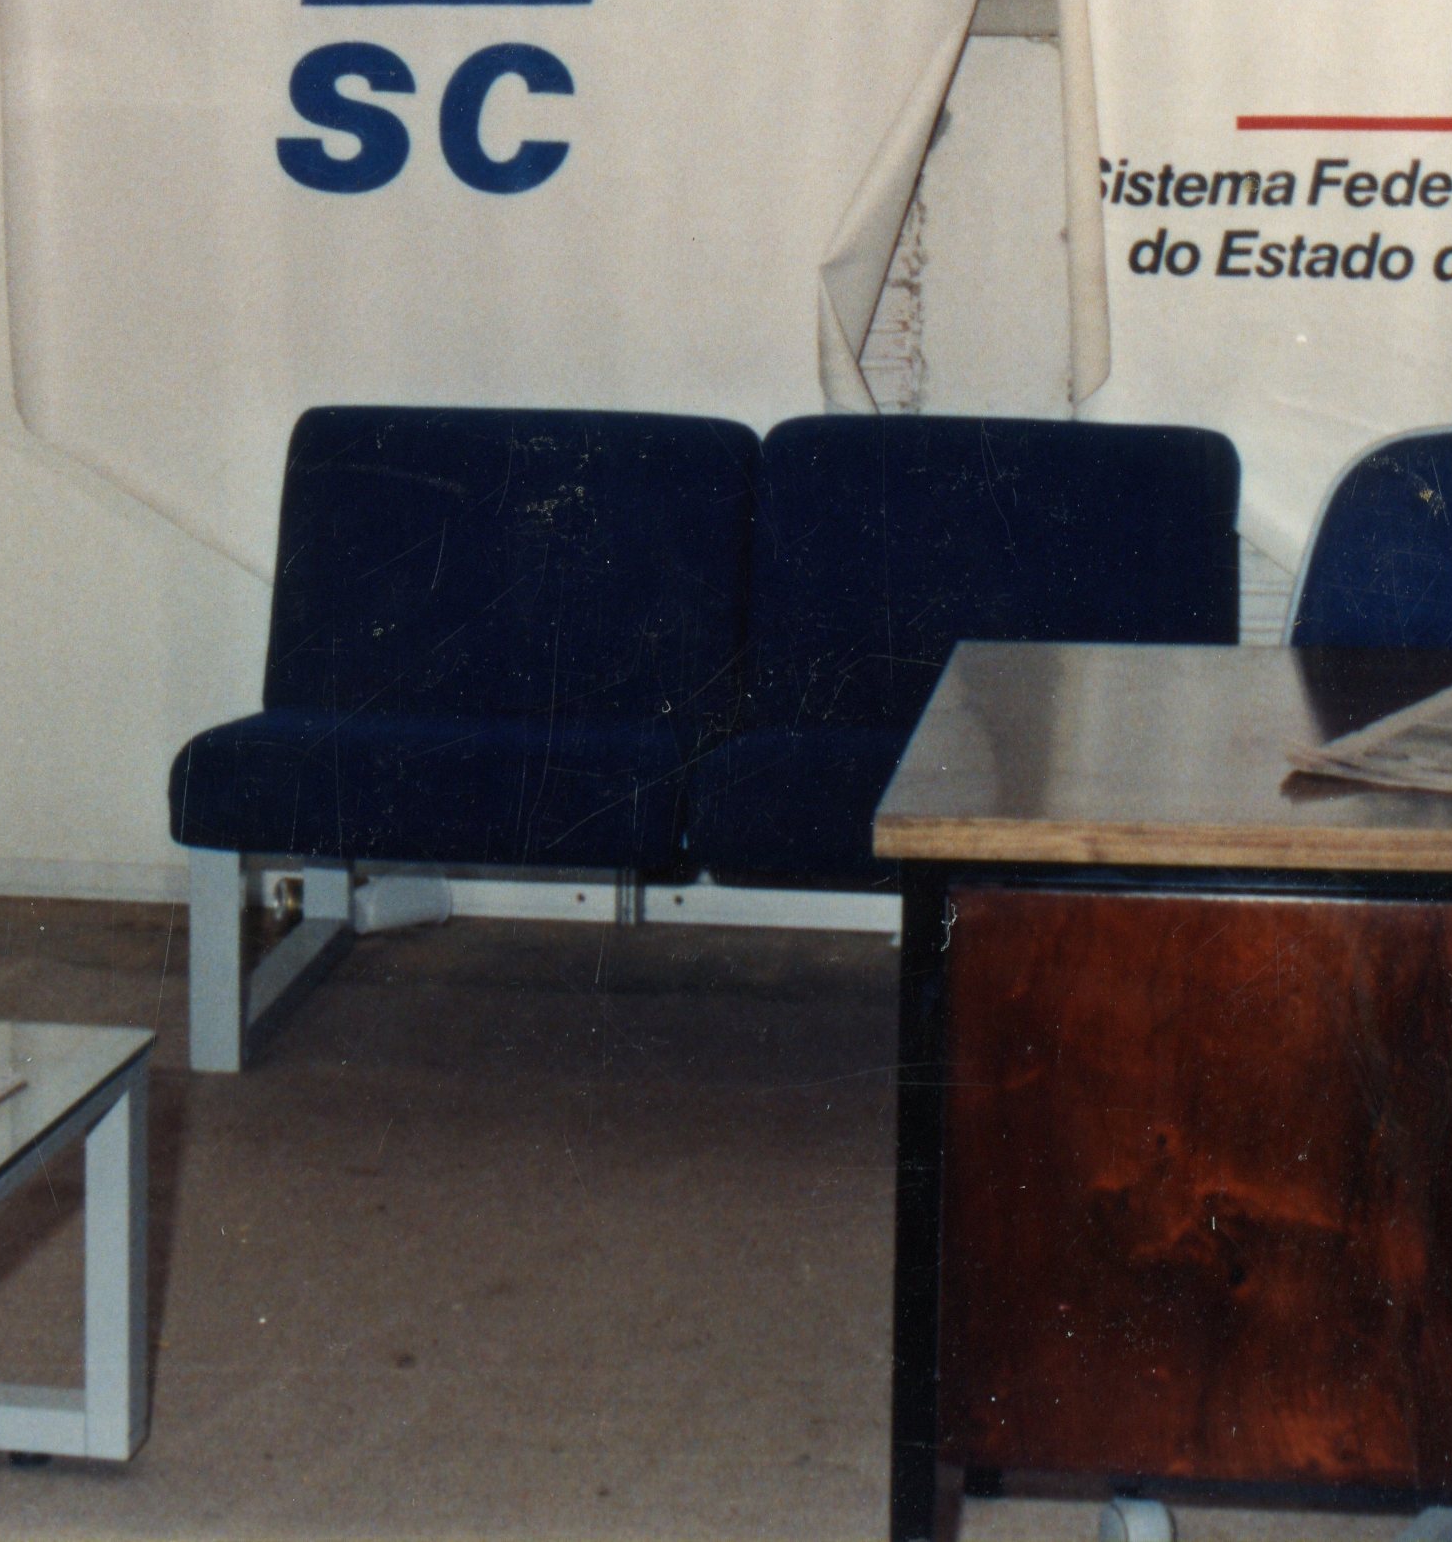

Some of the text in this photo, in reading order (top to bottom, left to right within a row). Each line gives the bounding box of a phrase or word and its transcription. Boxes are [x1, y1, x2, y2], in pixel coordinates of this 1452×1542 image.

[275, 40, 576, 195] SC
[1128, 227, 1202, 277] do
[1215, 228, 1414, 282] Estado
